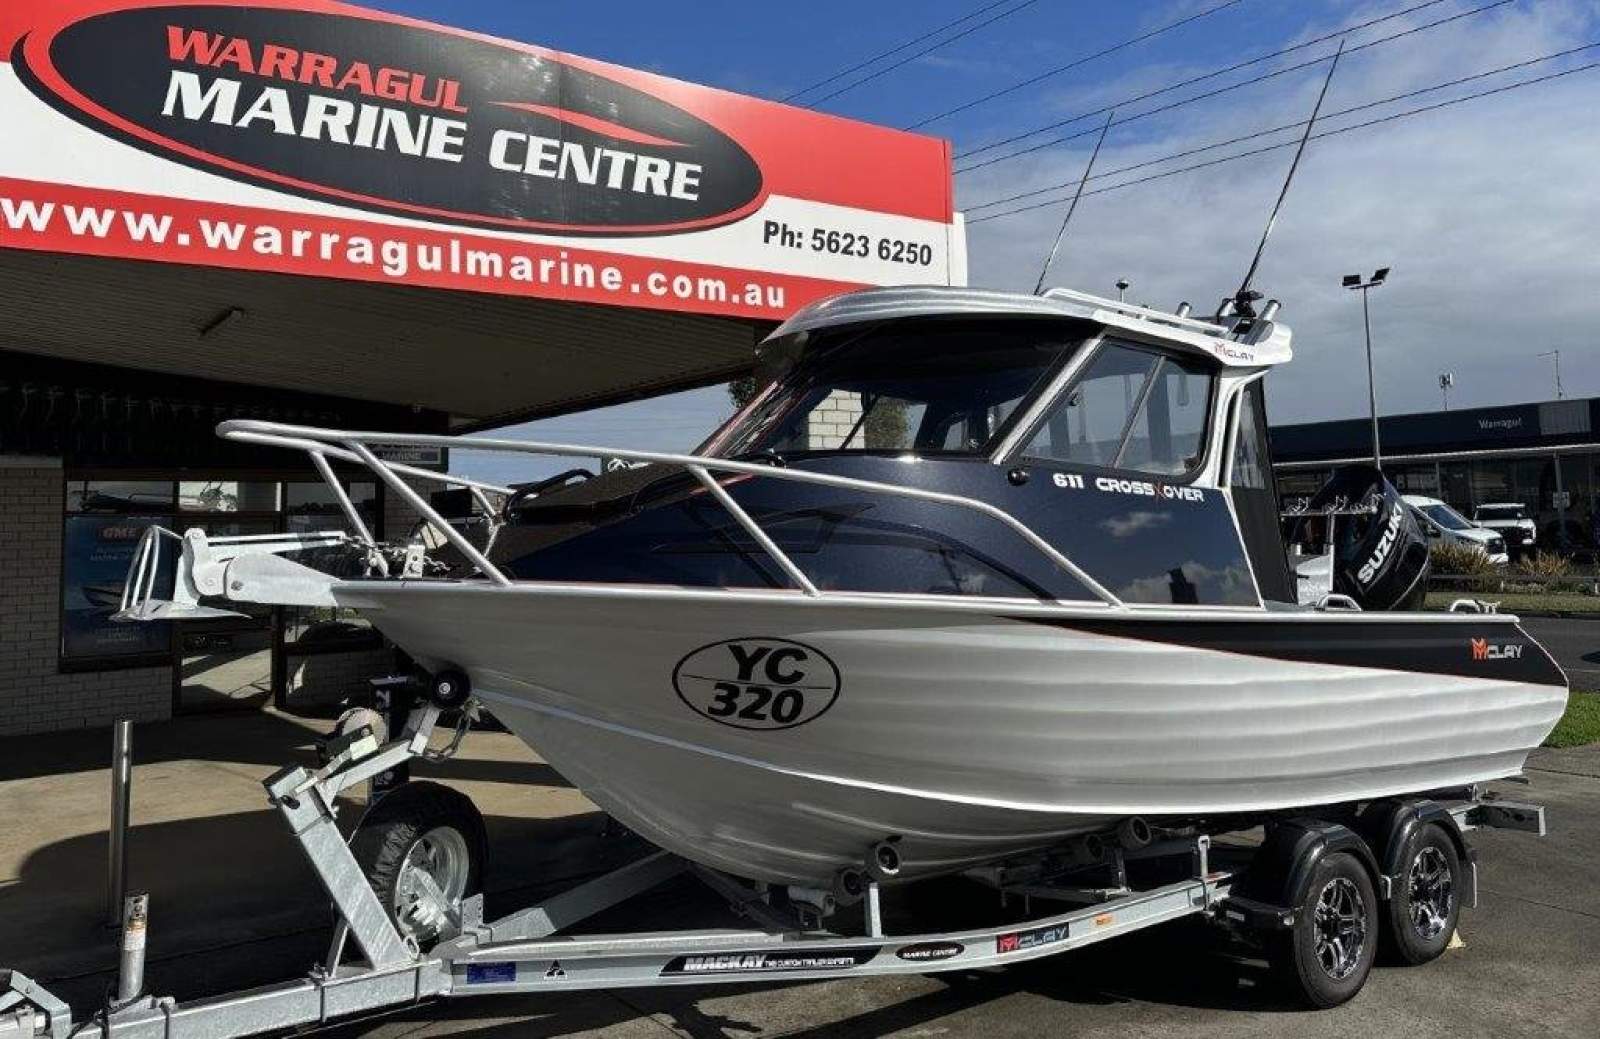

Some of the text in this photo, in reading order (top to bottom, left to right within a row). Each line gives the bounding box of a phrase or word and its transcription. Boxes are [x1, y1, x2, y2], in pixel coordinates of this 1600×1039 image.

[166, 25, 468, 113] WARRAGUL
[161, 70, 702, 201] MARINE CENTRE
[1, 199, 785, 309] www.warragulmarine.com.au
[764, 220, 932, 267] Ph: 5623 6250
[1053, 473, 1084, 489] 611
[1357, 502, 1402, 583] SUZUKI
[728, 645, 808, 684] YC
[707, 682, 804, 723] 320
[683, 954, 766, 971] MACKAY
